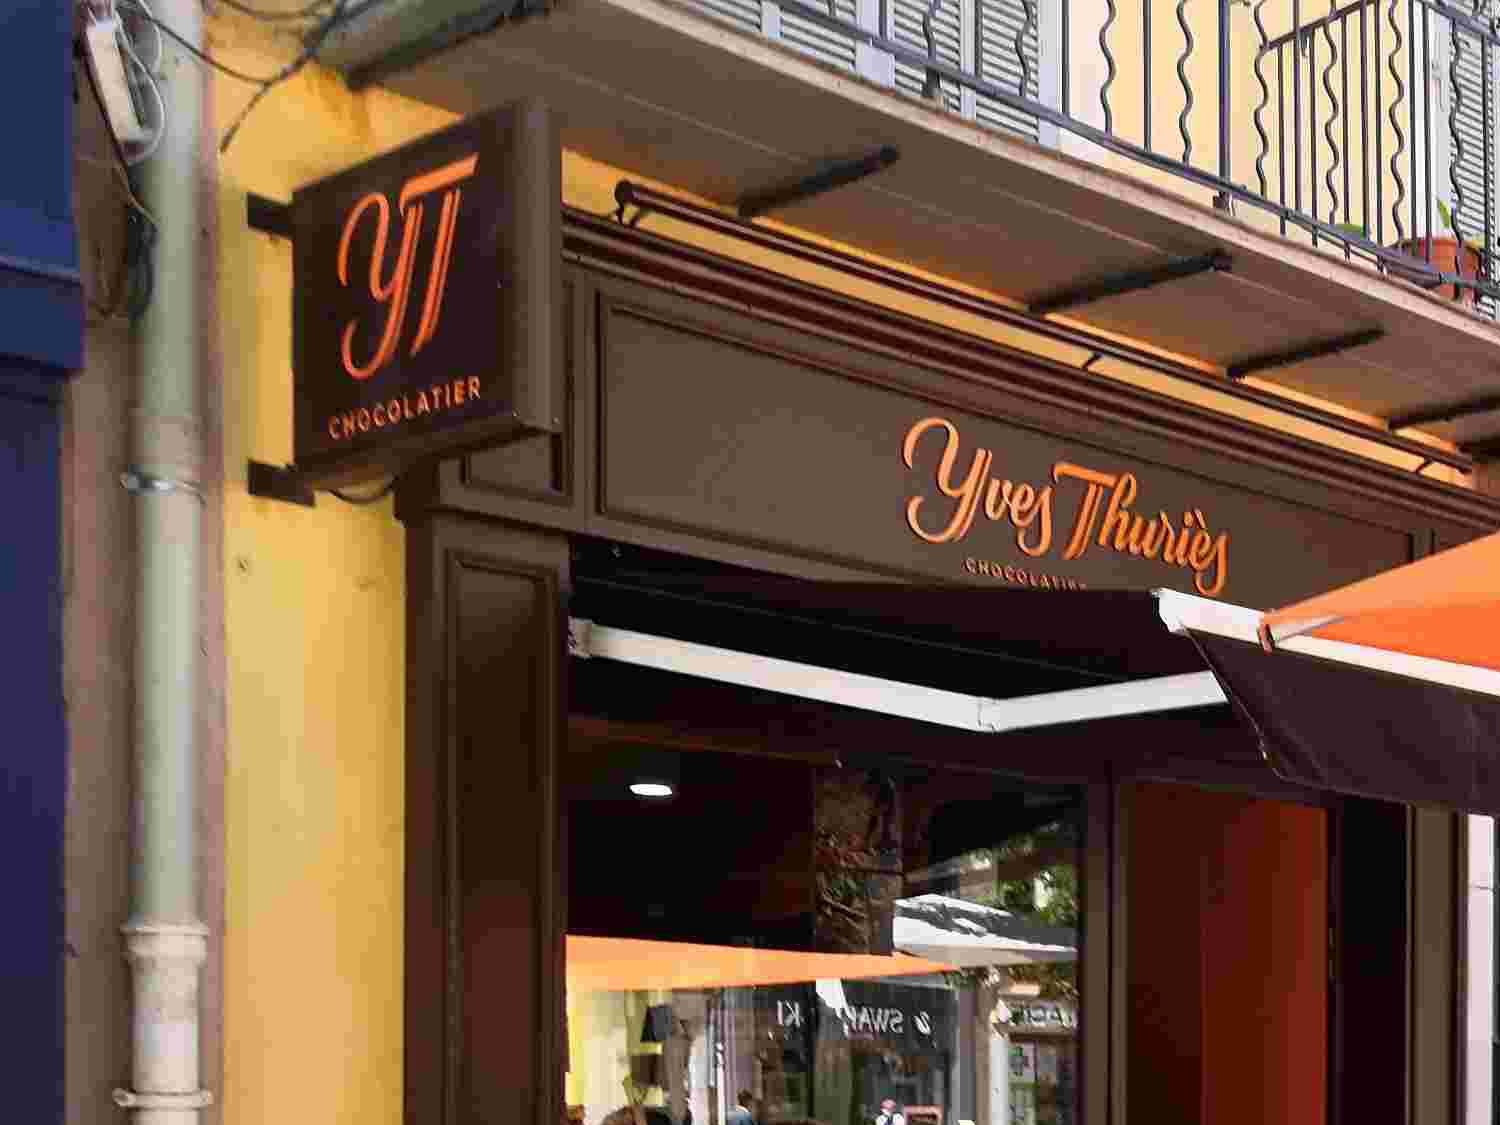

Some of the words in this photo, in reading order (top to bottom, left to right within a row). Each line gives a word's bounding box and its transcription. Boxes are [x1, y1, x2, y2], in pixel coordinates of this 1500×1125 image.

[328, 376, 482, 440] CHOCOLATIER
[903, 417, 1055, 557] Yves
[1053, 461, 1232, 597] Thuriès
